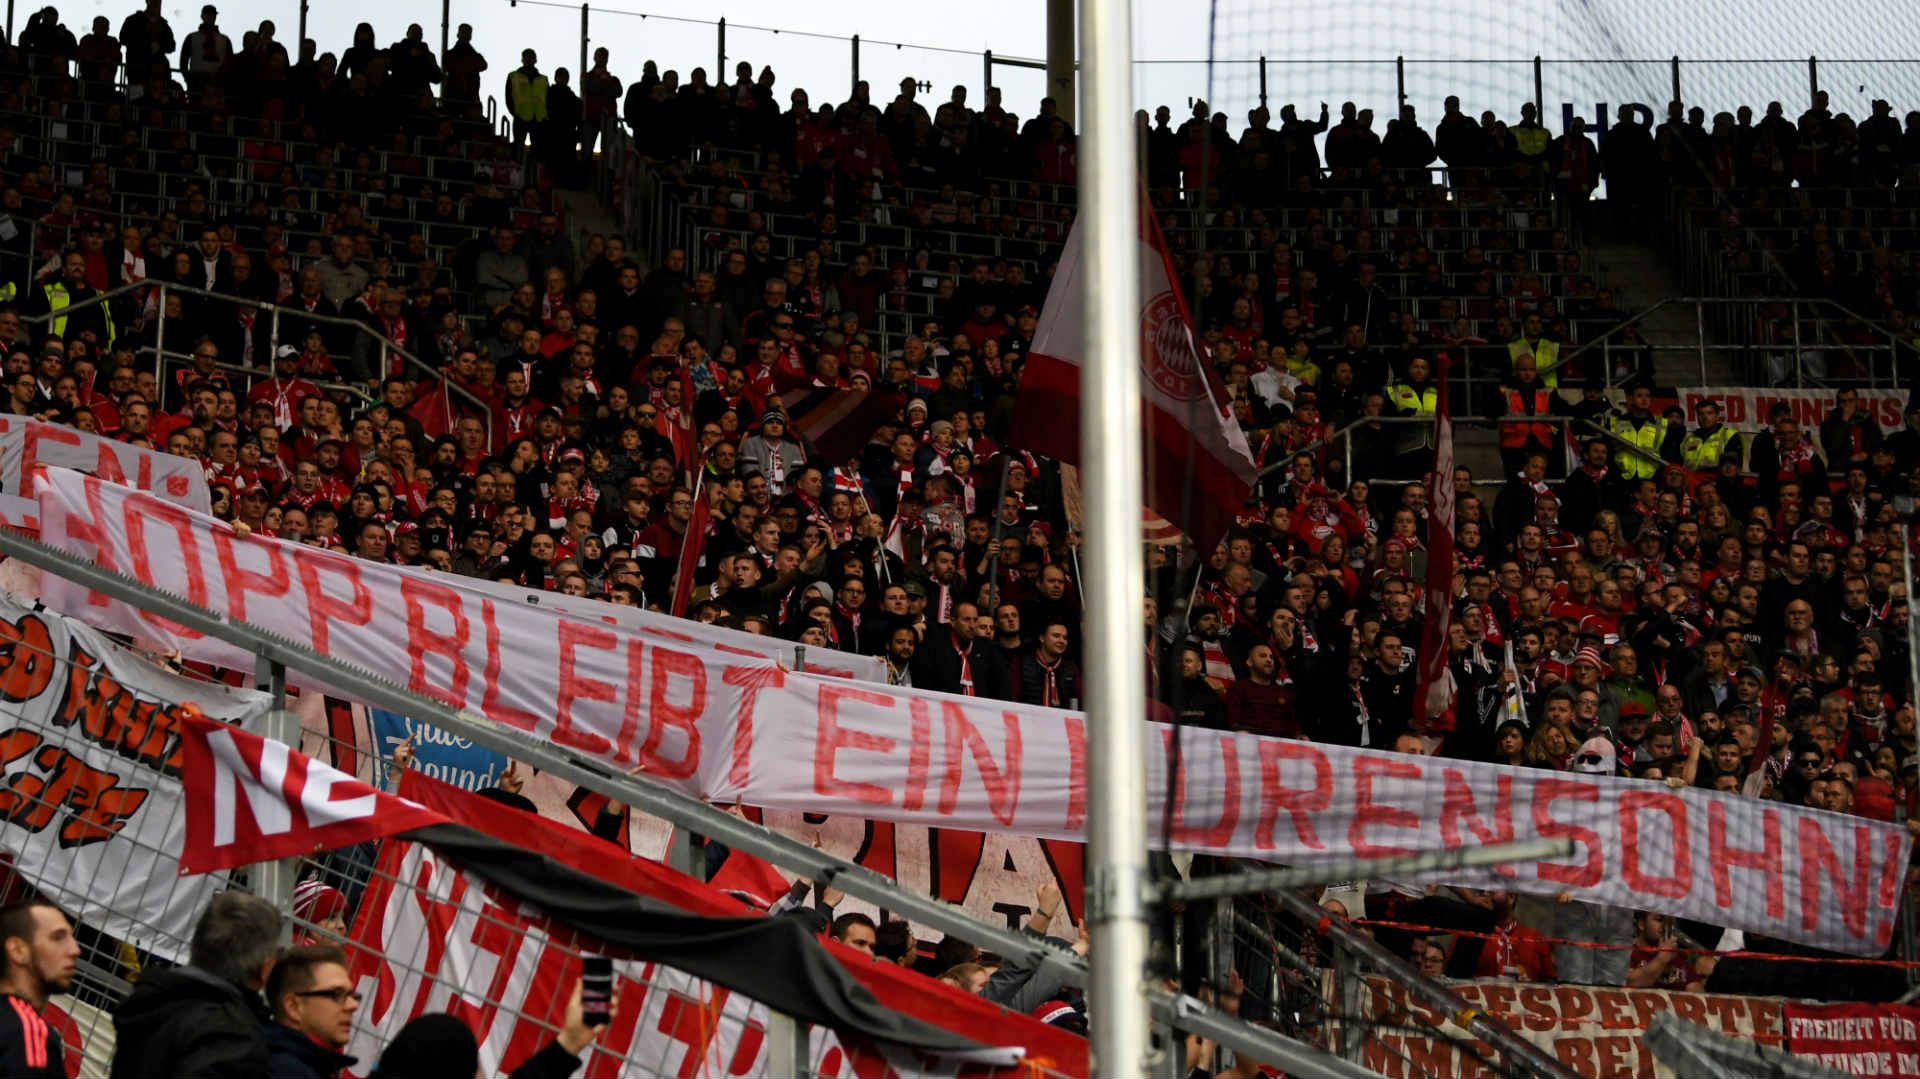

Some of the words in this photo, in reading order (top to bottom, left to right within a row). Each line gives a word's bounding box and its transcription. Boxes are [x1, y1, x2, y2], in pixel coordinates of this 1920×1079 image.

[34, 466, 373, 657] HOPP
[400, 575, 786, 788] BLEIBT
[814, 683, 1023, 827] EIN
[1789, 1016, 1874, 1041] FREIHEIT
[1878, 1011, 1918, 1041] FÜR
